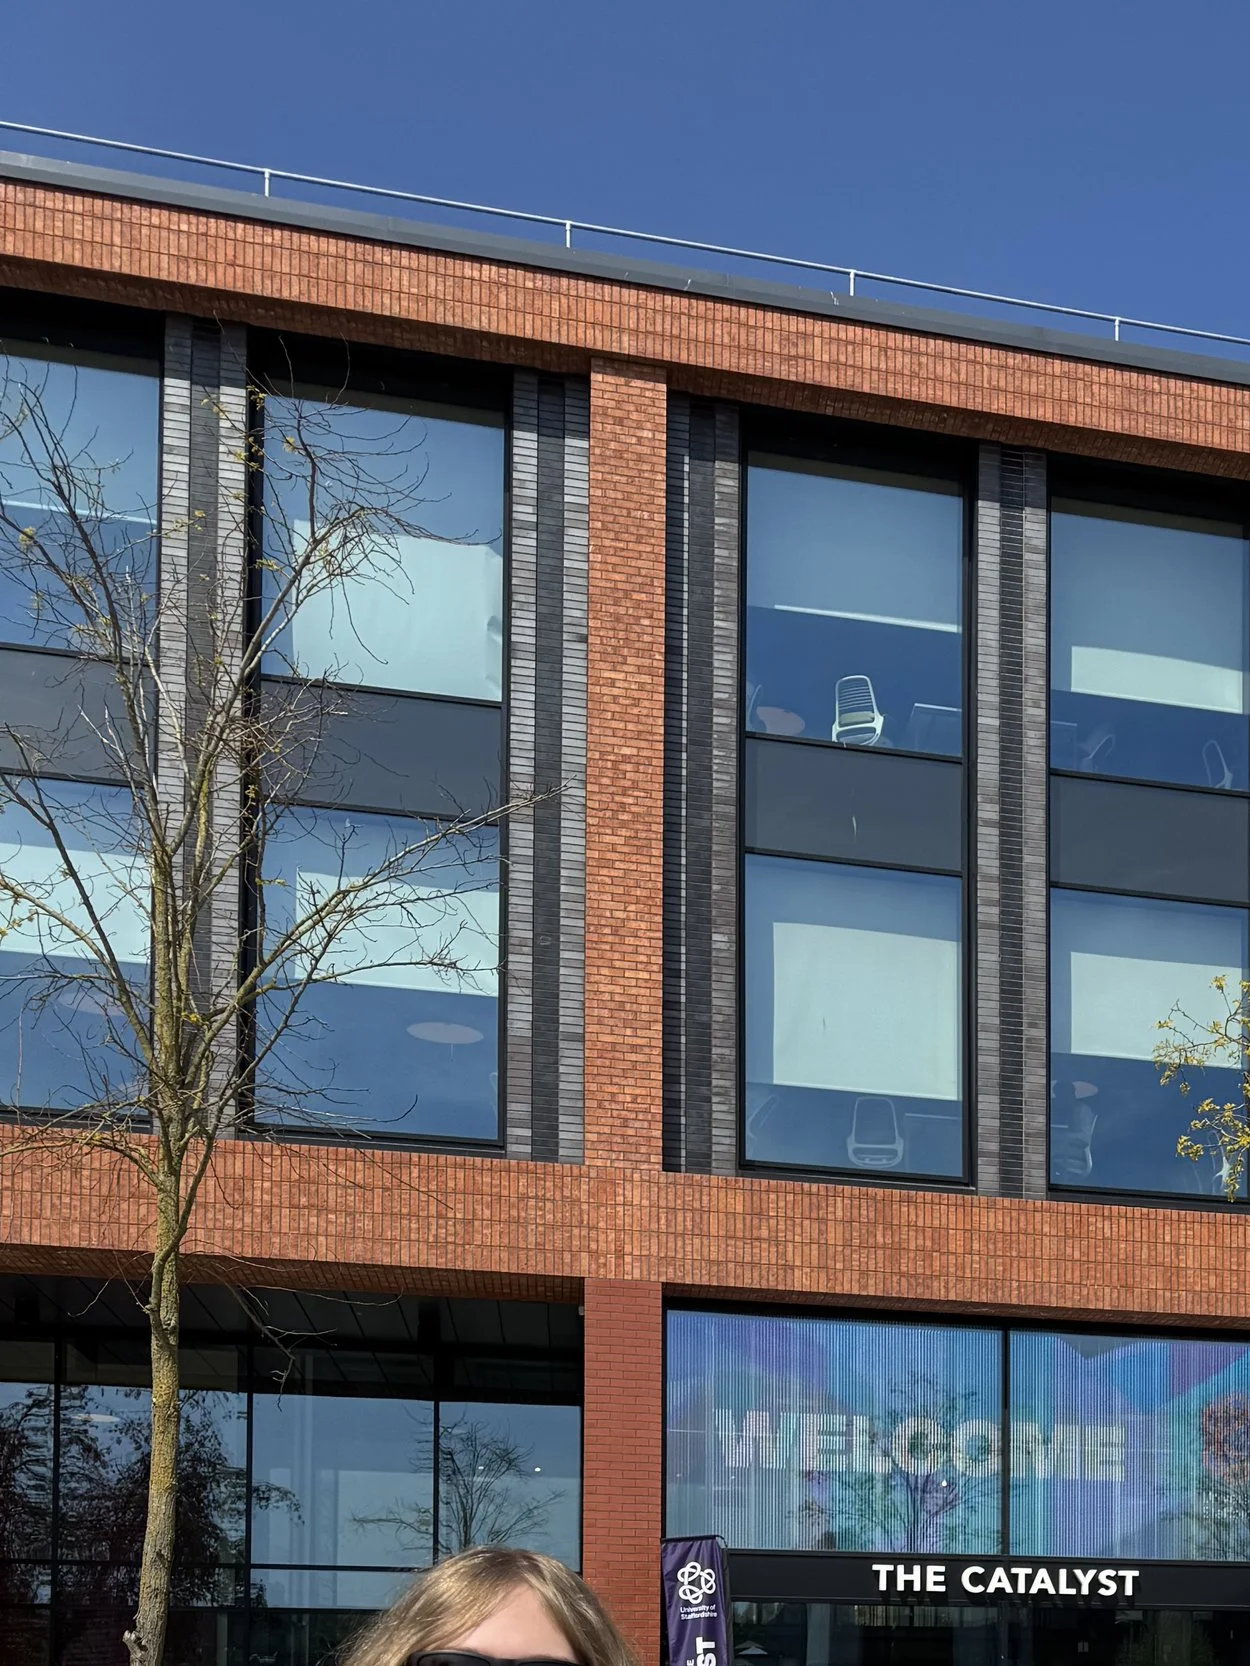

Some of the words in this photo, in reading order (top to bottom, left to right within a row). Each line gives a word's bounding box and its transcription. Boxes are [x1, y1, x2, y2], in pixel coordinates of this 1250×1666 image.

[714, 1408, 1126, 1483] WELCOME
[872, 1564, 946, 1592] THE
[961, 1566, 1140, 1596] CATALYST
